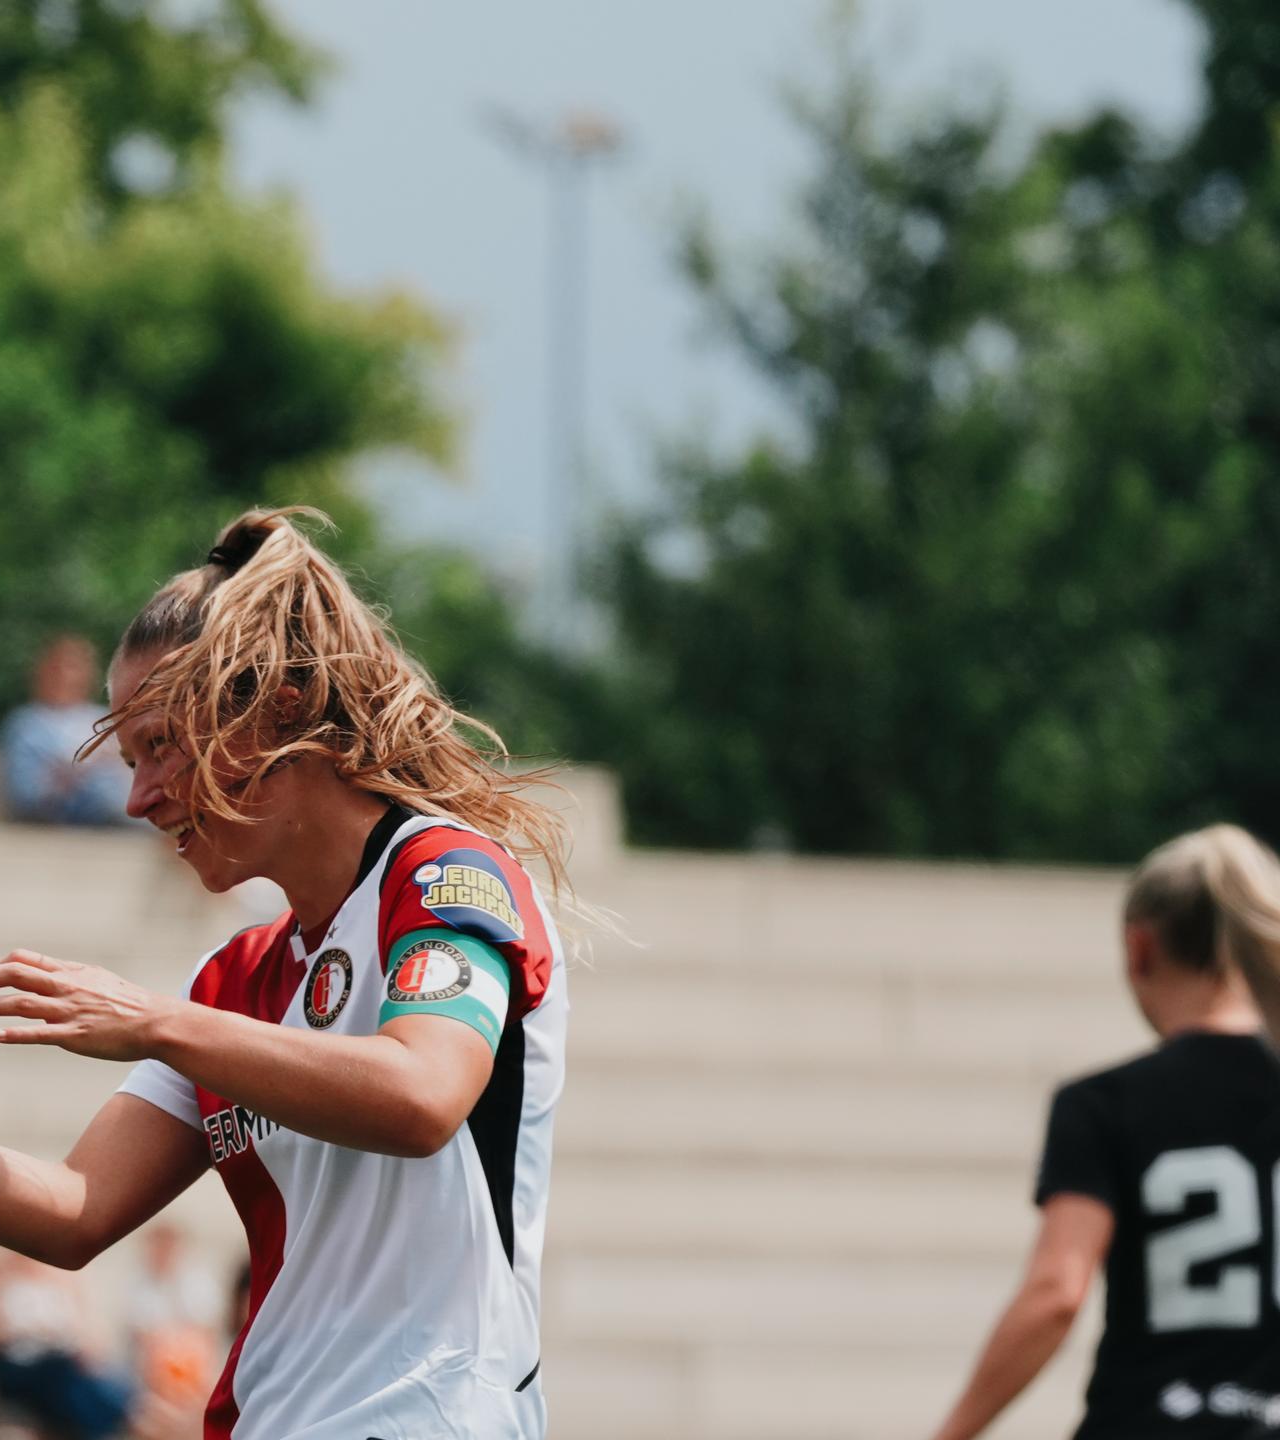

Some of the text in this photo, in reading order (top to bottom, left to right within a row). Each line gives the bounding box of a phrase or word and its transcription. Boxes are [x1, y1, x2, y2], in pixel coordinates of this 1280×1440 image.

[424, 884, 524, 937] JACKPOT
[446, 866, 505, 902] EURO
[1142, 1144, 1280, 1332] 2
